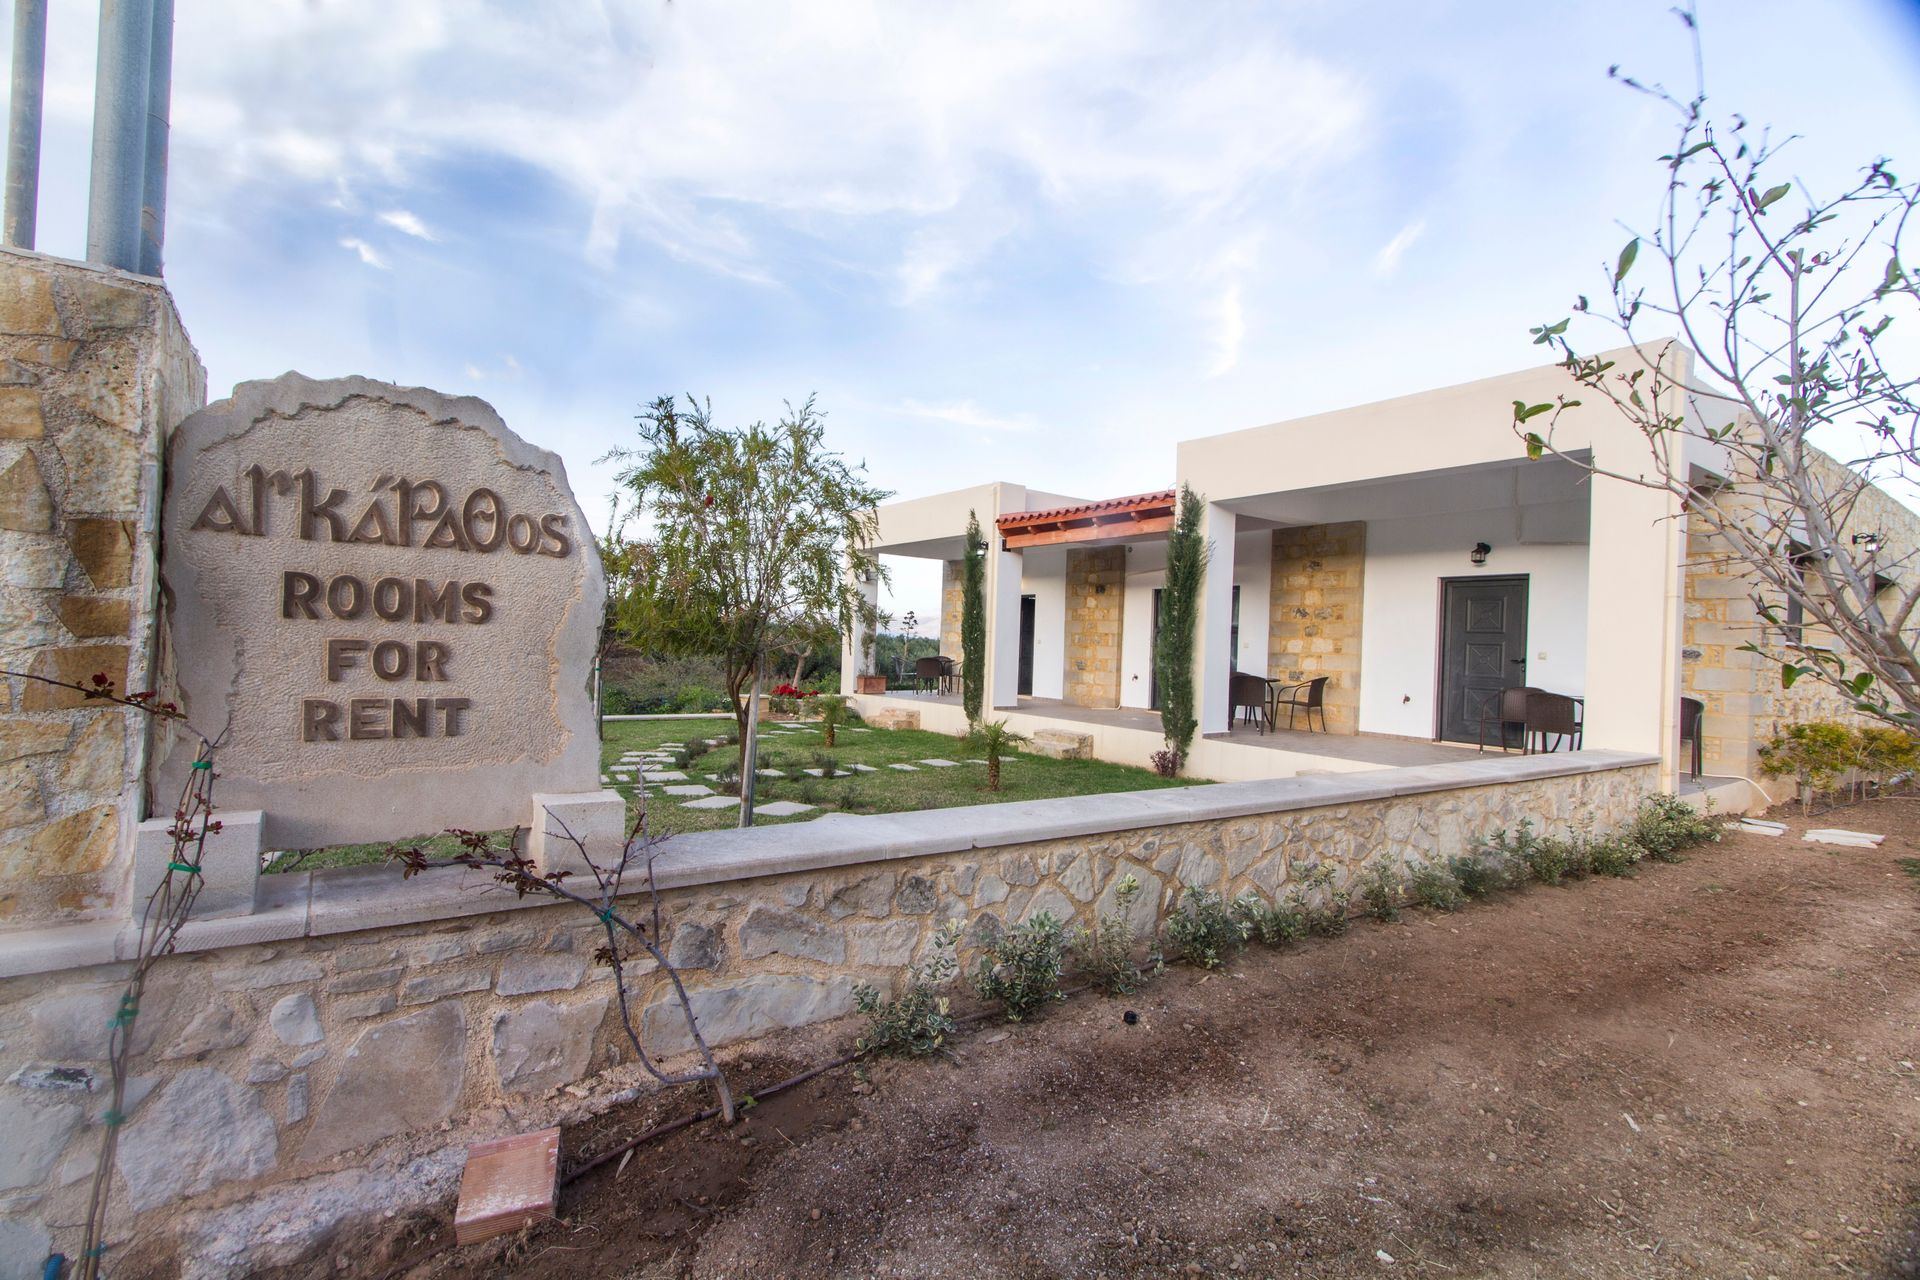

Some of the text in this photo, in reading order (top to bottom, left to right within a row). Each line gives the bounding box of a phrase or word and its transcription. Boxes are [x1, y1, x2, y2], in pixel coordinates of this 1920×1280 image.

[282, 570, 494, 624] ROOMS
[326, 638, 451, 683] FOR
[302, 697, 471, 742] RENT
